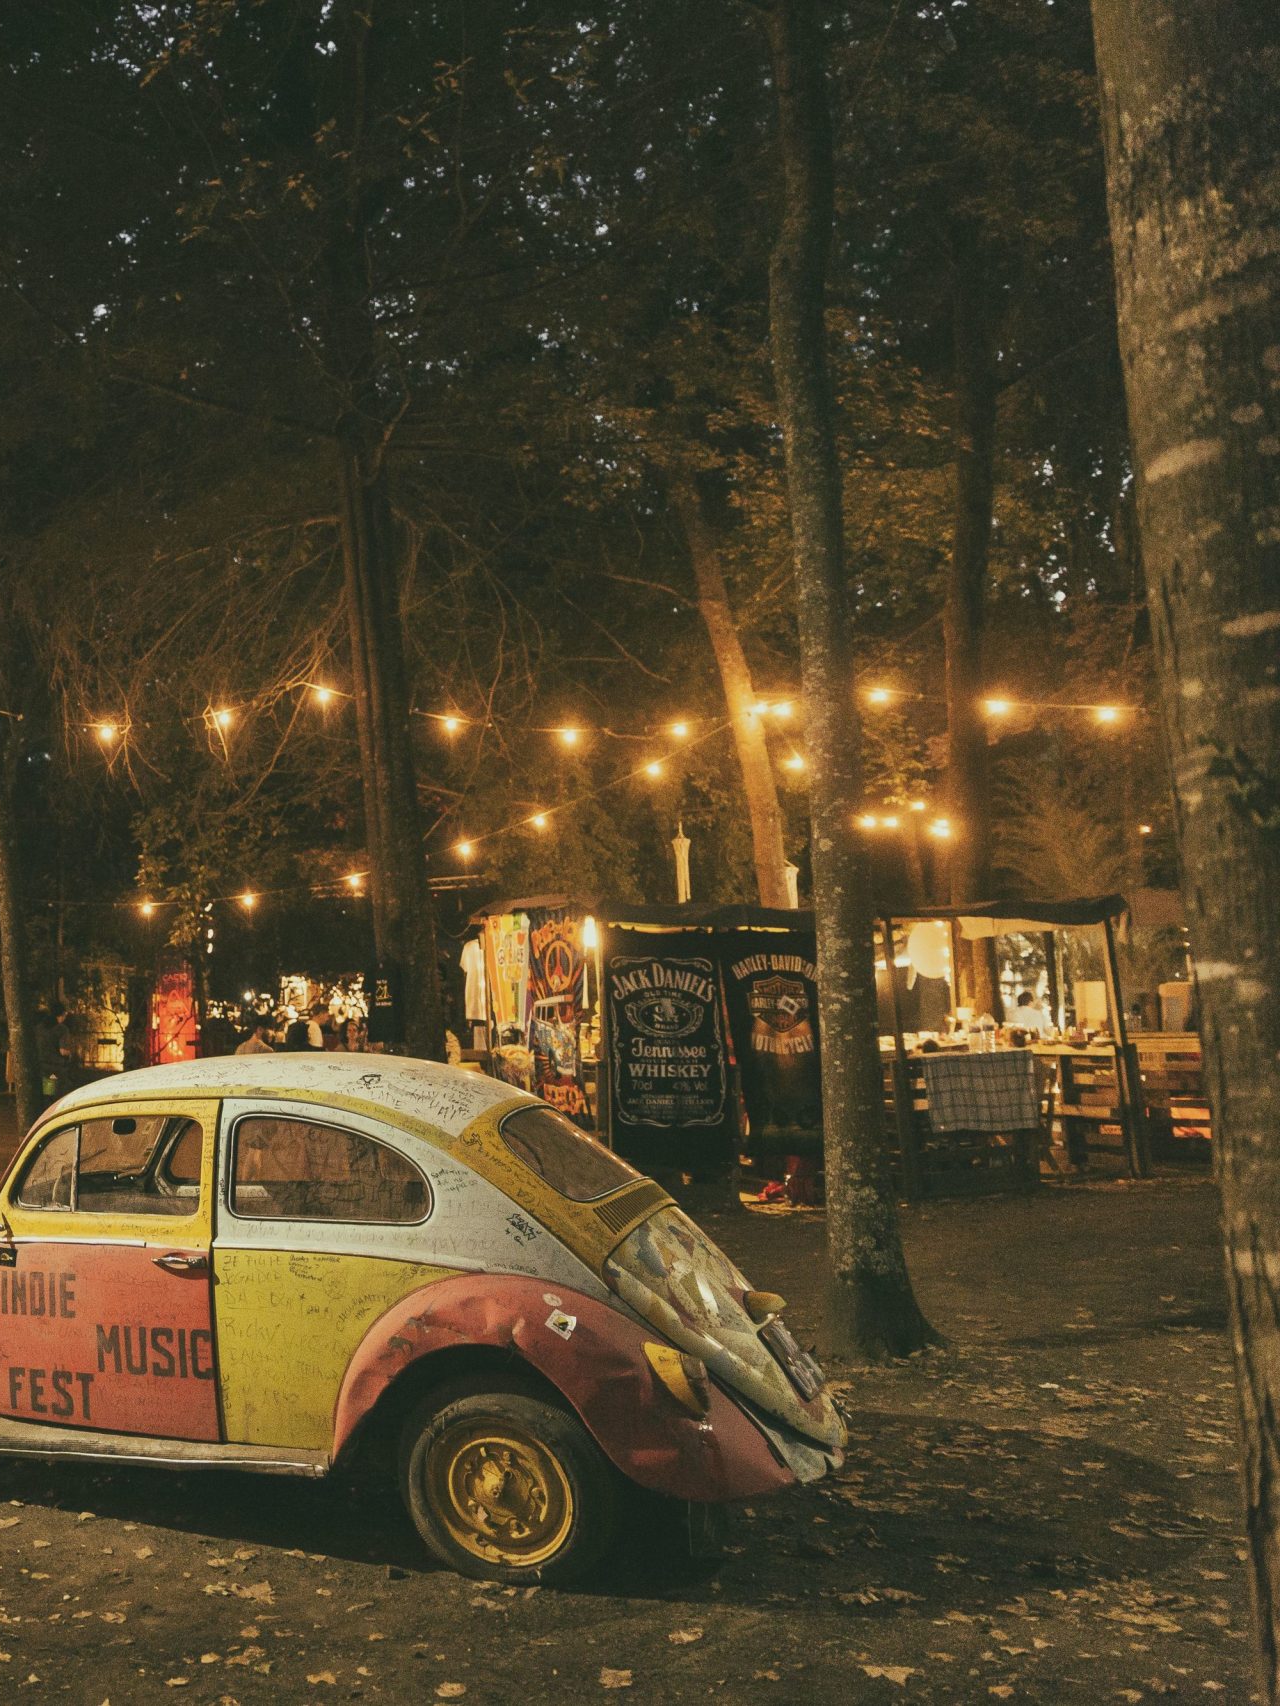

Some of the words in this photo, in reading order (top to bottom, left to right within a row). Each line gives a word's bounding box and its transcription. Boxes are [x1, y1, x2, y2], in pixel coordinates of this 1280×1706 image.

[611, 969, 654, 1000] JACK
[652, 962, 716, 1002] DANIEL'S
[628, 1063, 712, 1078] WHISKEY
[1, 1270, 76, 1319] INDIE
[96, 1324, 214, 1381] MUSIC
[9, 1366, 95, 1421] FEST
